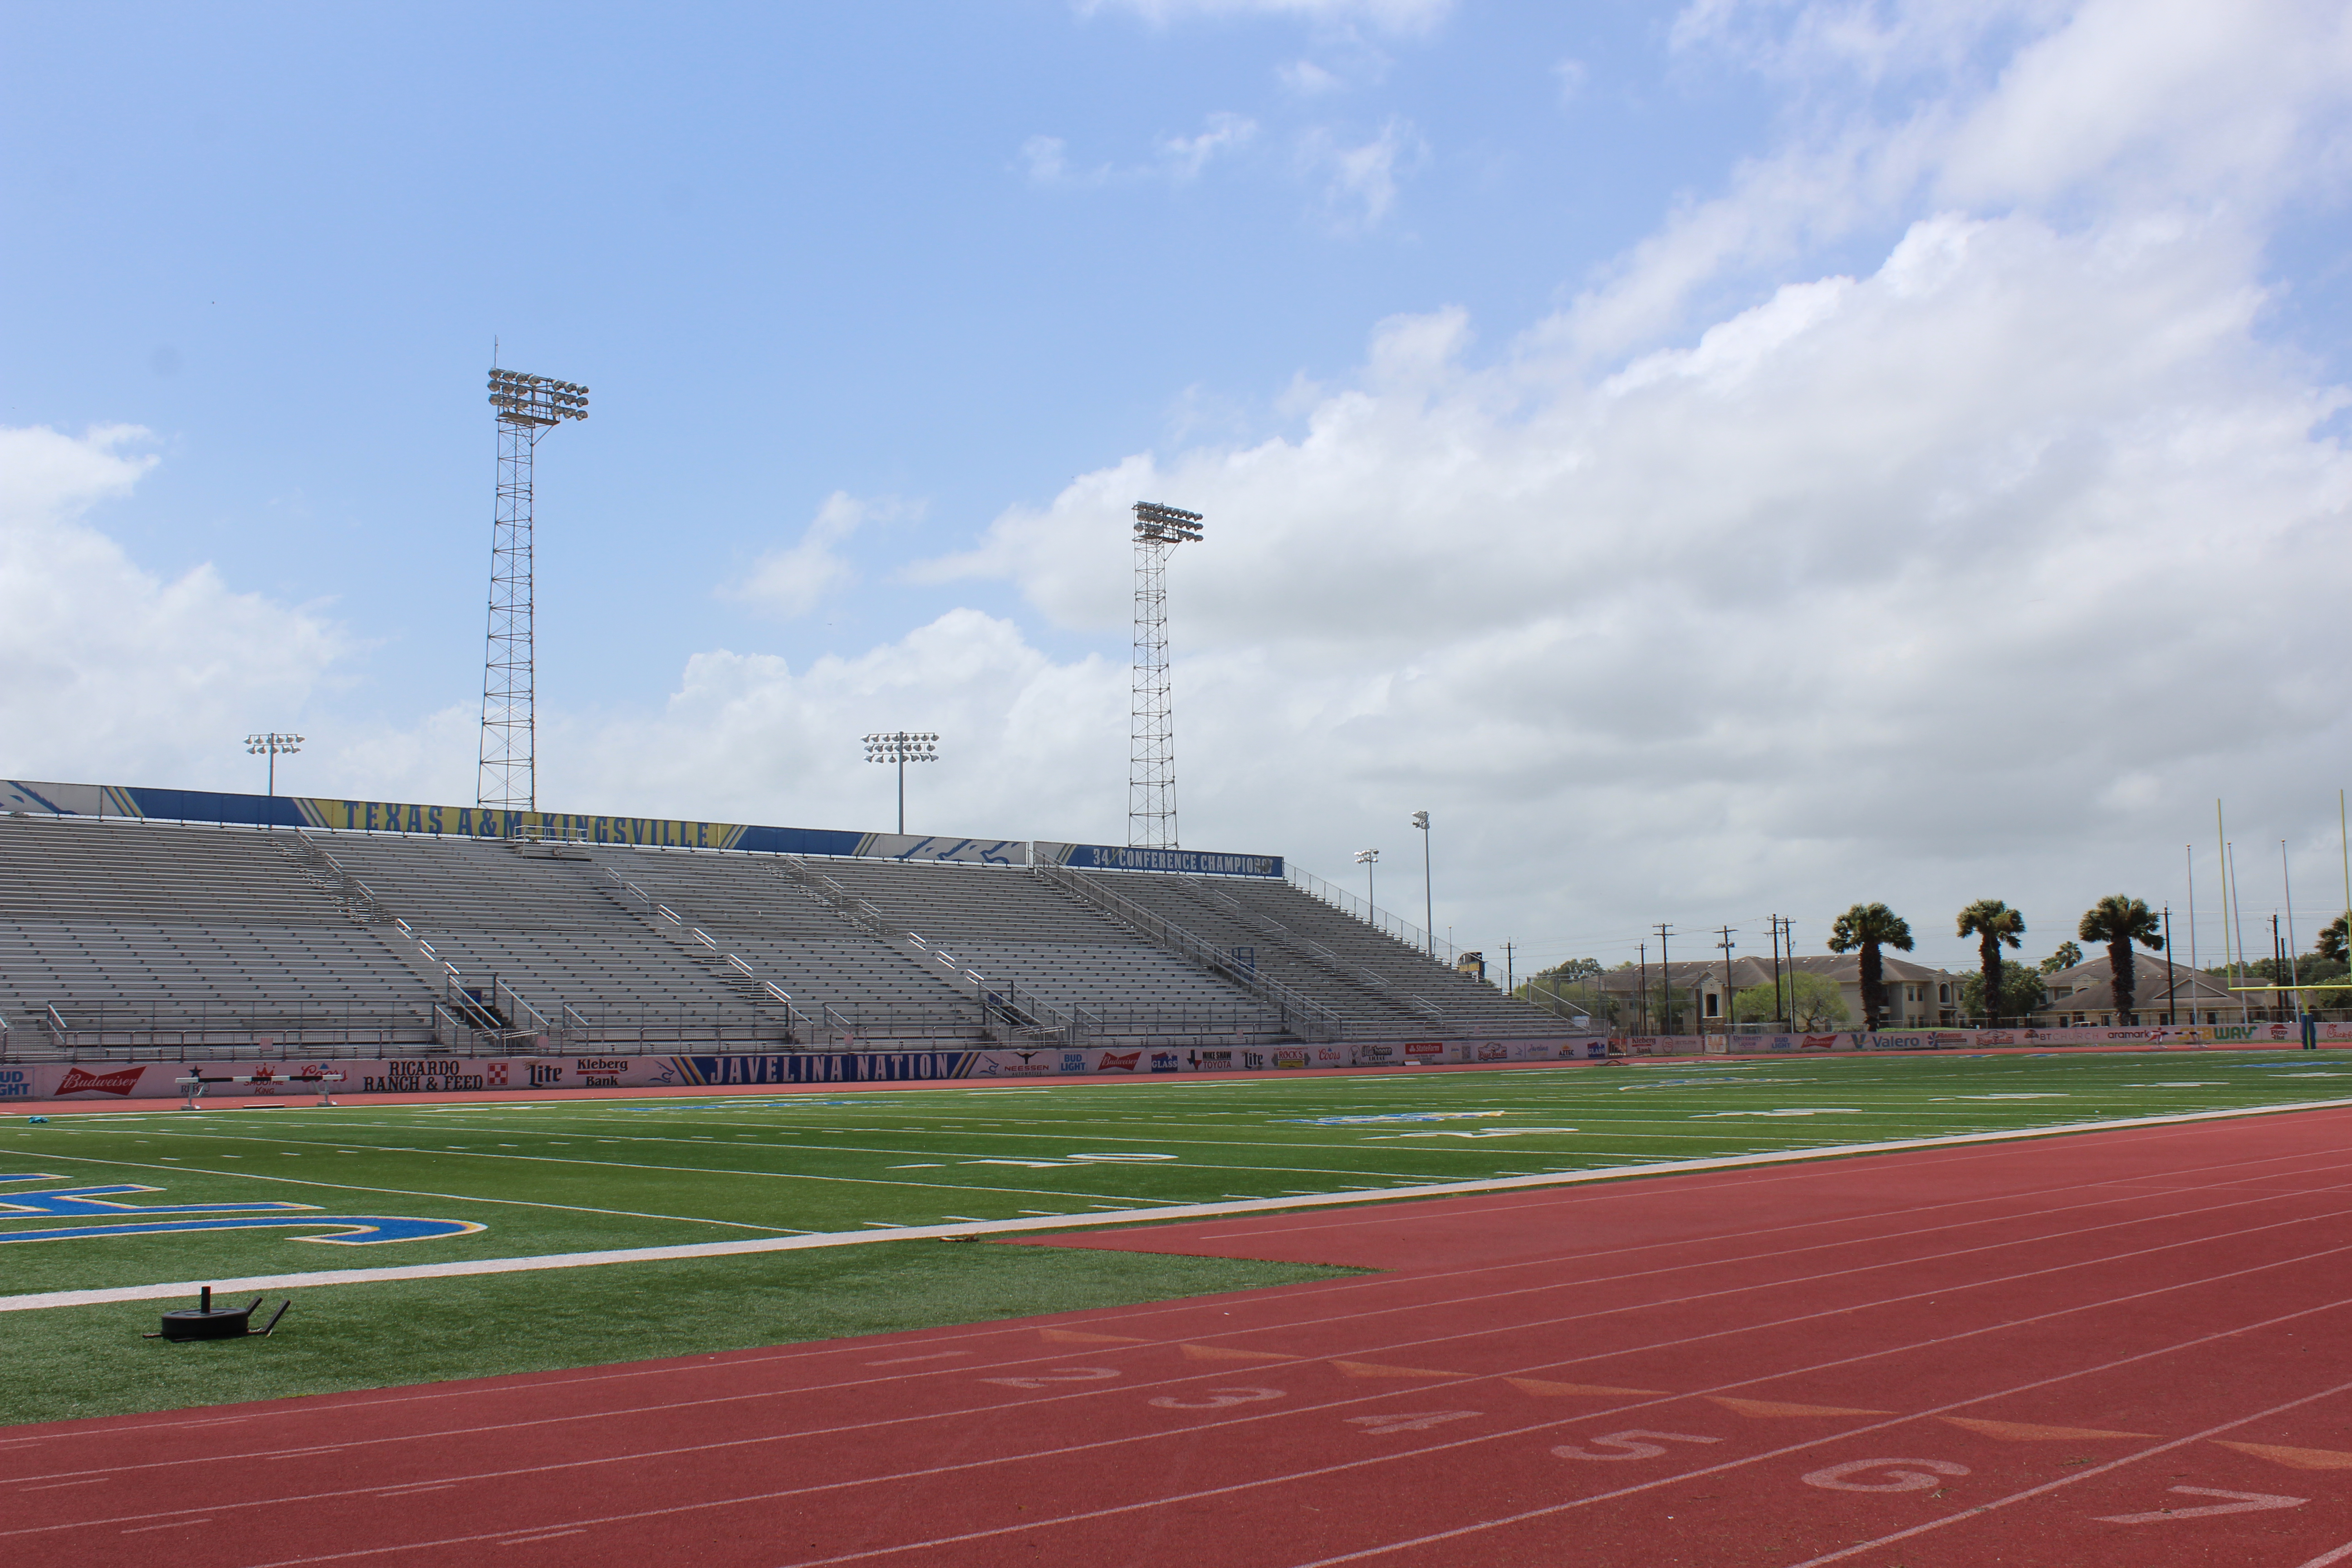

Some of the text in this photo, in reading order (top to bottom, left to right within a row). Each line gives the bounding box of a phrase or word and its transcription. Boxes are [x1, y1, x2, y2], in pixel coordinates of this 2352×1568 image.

[343, 801, 443, 835] TEXAS
[1093, 848, 1109, 866] 34
[1118, 850, 1196, 871] CONFERENCE
[1872, 1036, 1920, 1048] Valero
[2107, 1029, 2150, 1039] aramark
[1064, 1054, 1083, 1063] BUD
[1101, 1056, 1138, 1066] Budweiser
[1202, 1051, 1215, 1060] MIKE
[1216, 1051, 1232, 1059] SHAW
[1243, 1051, 1264, 1069] Lite
[1318, 1049, 1340, 1060] Coors
[389, 1060, 460, 1076] RICARDO
[577, 1058, 628, 1072] Kleberg
[710, 1054, 949, 1084] JAVELINA NATION
[1060, 1062, 1086, 1072] LIGHT
[1152, 1060, 1178, 1068] GLASS
[1204, 1060, 1231, 1069] TOYOTA
[61, 1073, 138, 1088] Budweiser
[363, 1074, 484, 1092] RANCH & FEED
[529, 1064, 563, 1088] Lite
[586, 1076, 619, 1087] Bank
[975, 1367, 1122, 1389] 2
[1147, 1387, 1289, 1409] 3
[1341, 1410, 1487, 1435] 4
[1550, 1429, 1725, 1461] 5
[1800, 1457, 1972, 1493] 6
[2089, 1485, 2312, 1524] 7
